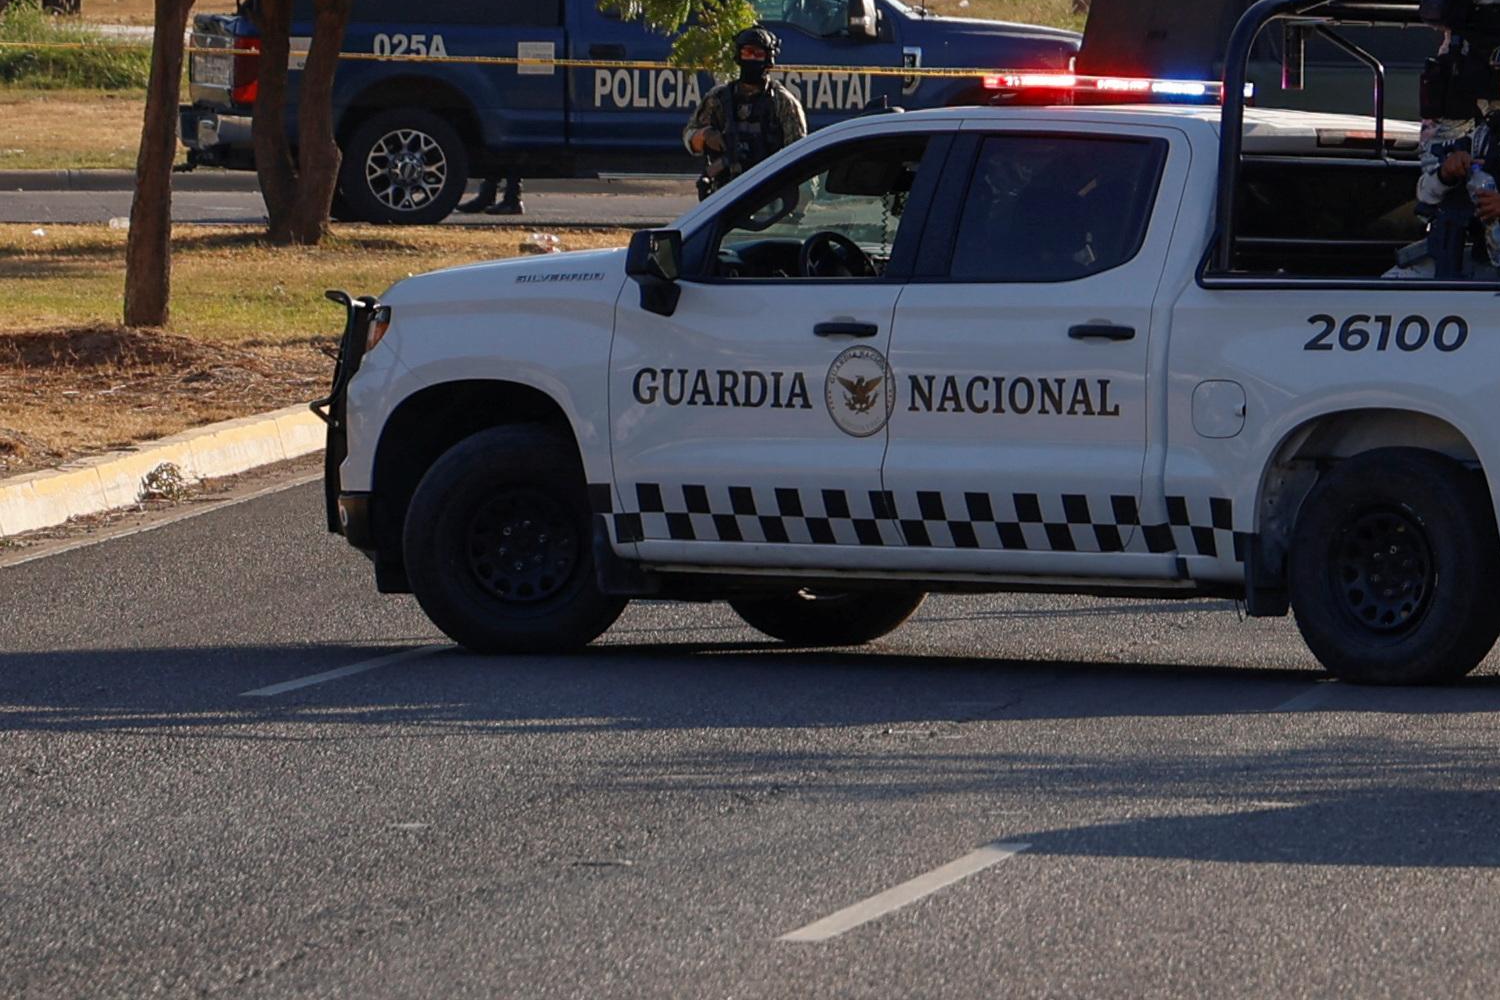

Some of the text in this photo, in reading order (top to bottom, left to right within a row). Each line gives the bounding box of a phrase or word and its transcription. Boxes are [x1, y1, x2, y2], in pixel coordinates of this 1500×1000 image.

[373, 34, 448, 60] 025A
[595, 69, 701, 108] POLICIA
[1304, 314, 1468, 351] 26100
[633, 367, 1120, 416] GUARDIA NACIONAL
